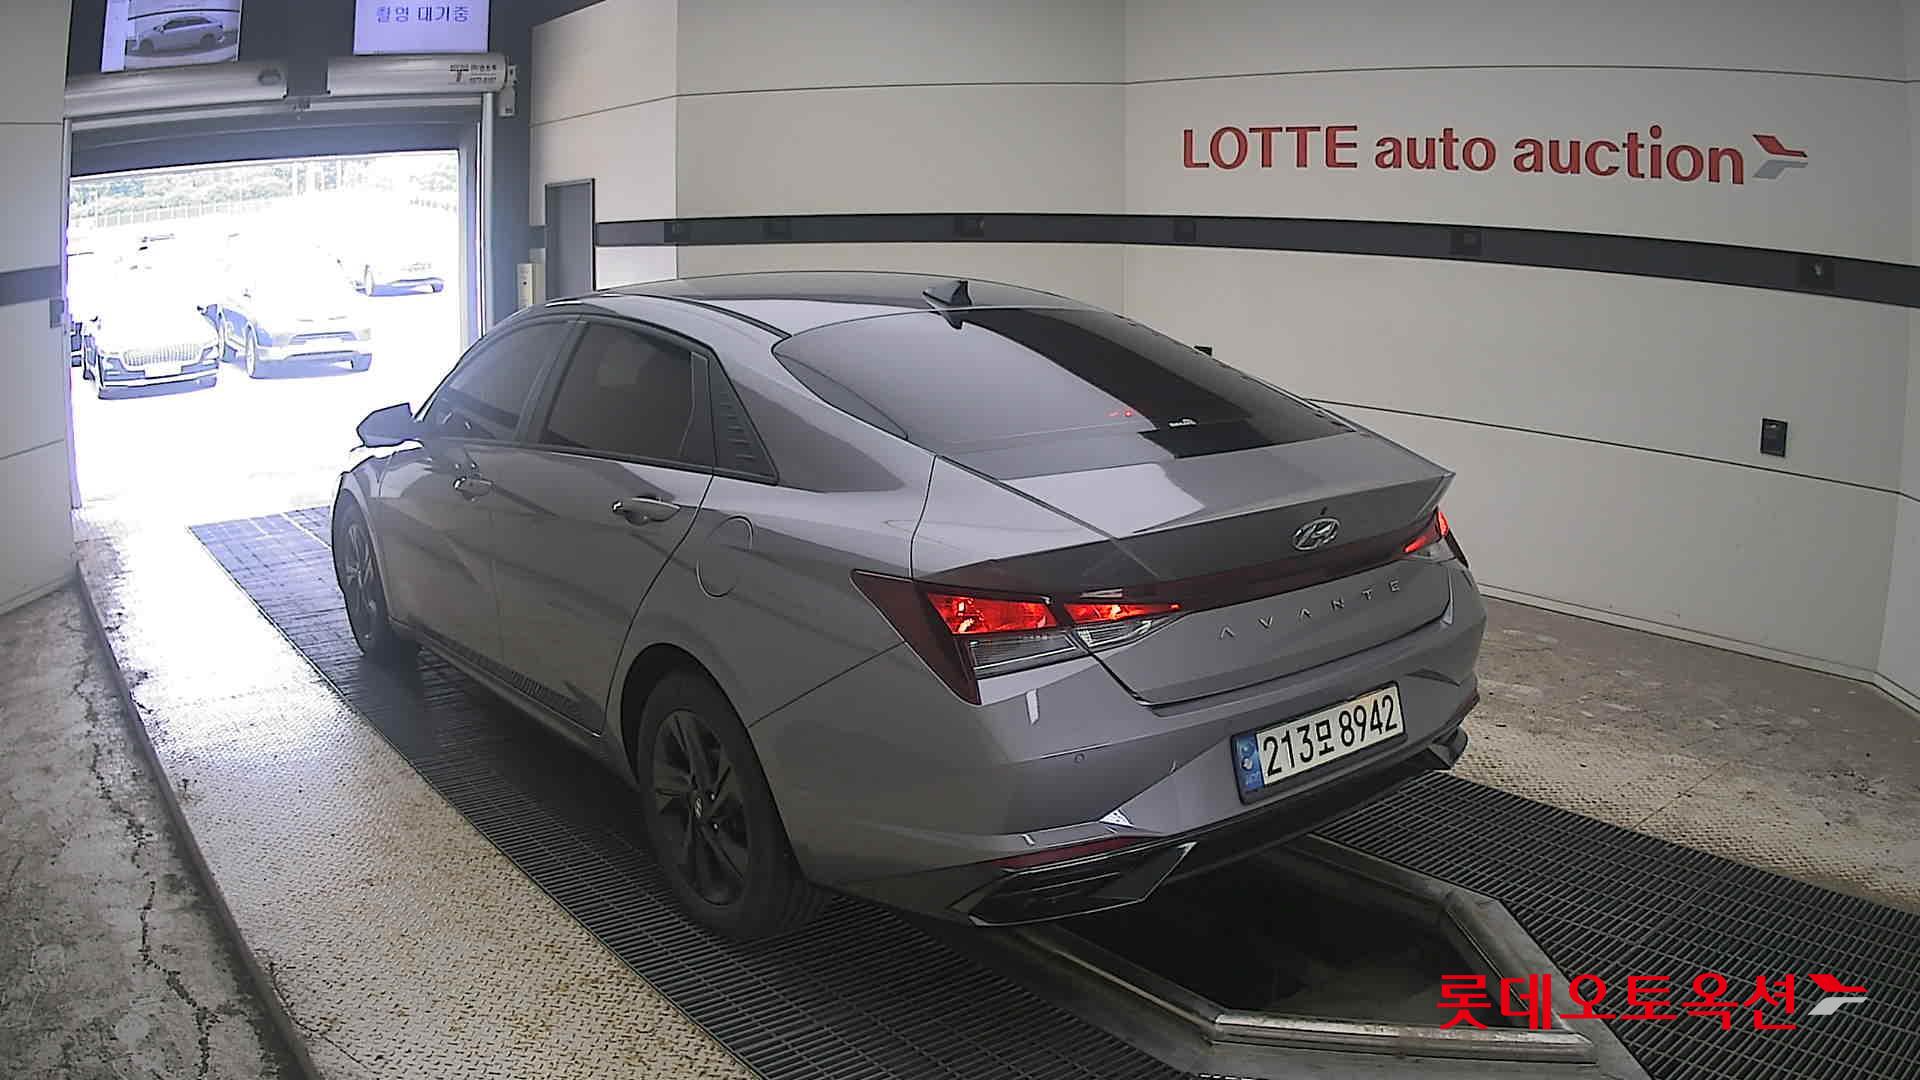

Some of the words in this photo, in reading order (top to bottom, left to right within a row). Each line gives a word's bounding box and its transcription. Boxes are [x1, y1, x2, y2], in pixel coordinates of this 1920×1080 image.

[417, 5, 470, 23] 대기중
[1183, 125, 1358, 169] LOTTE
[1375, 128, 1497, 171] auto
[1513, 125, 1745, 185] auction
[1218, 579, 1401, 641] AVANTE
[1263, 718, 1334, 777] 213모
[1338, 694, 1398, 747] 8942
